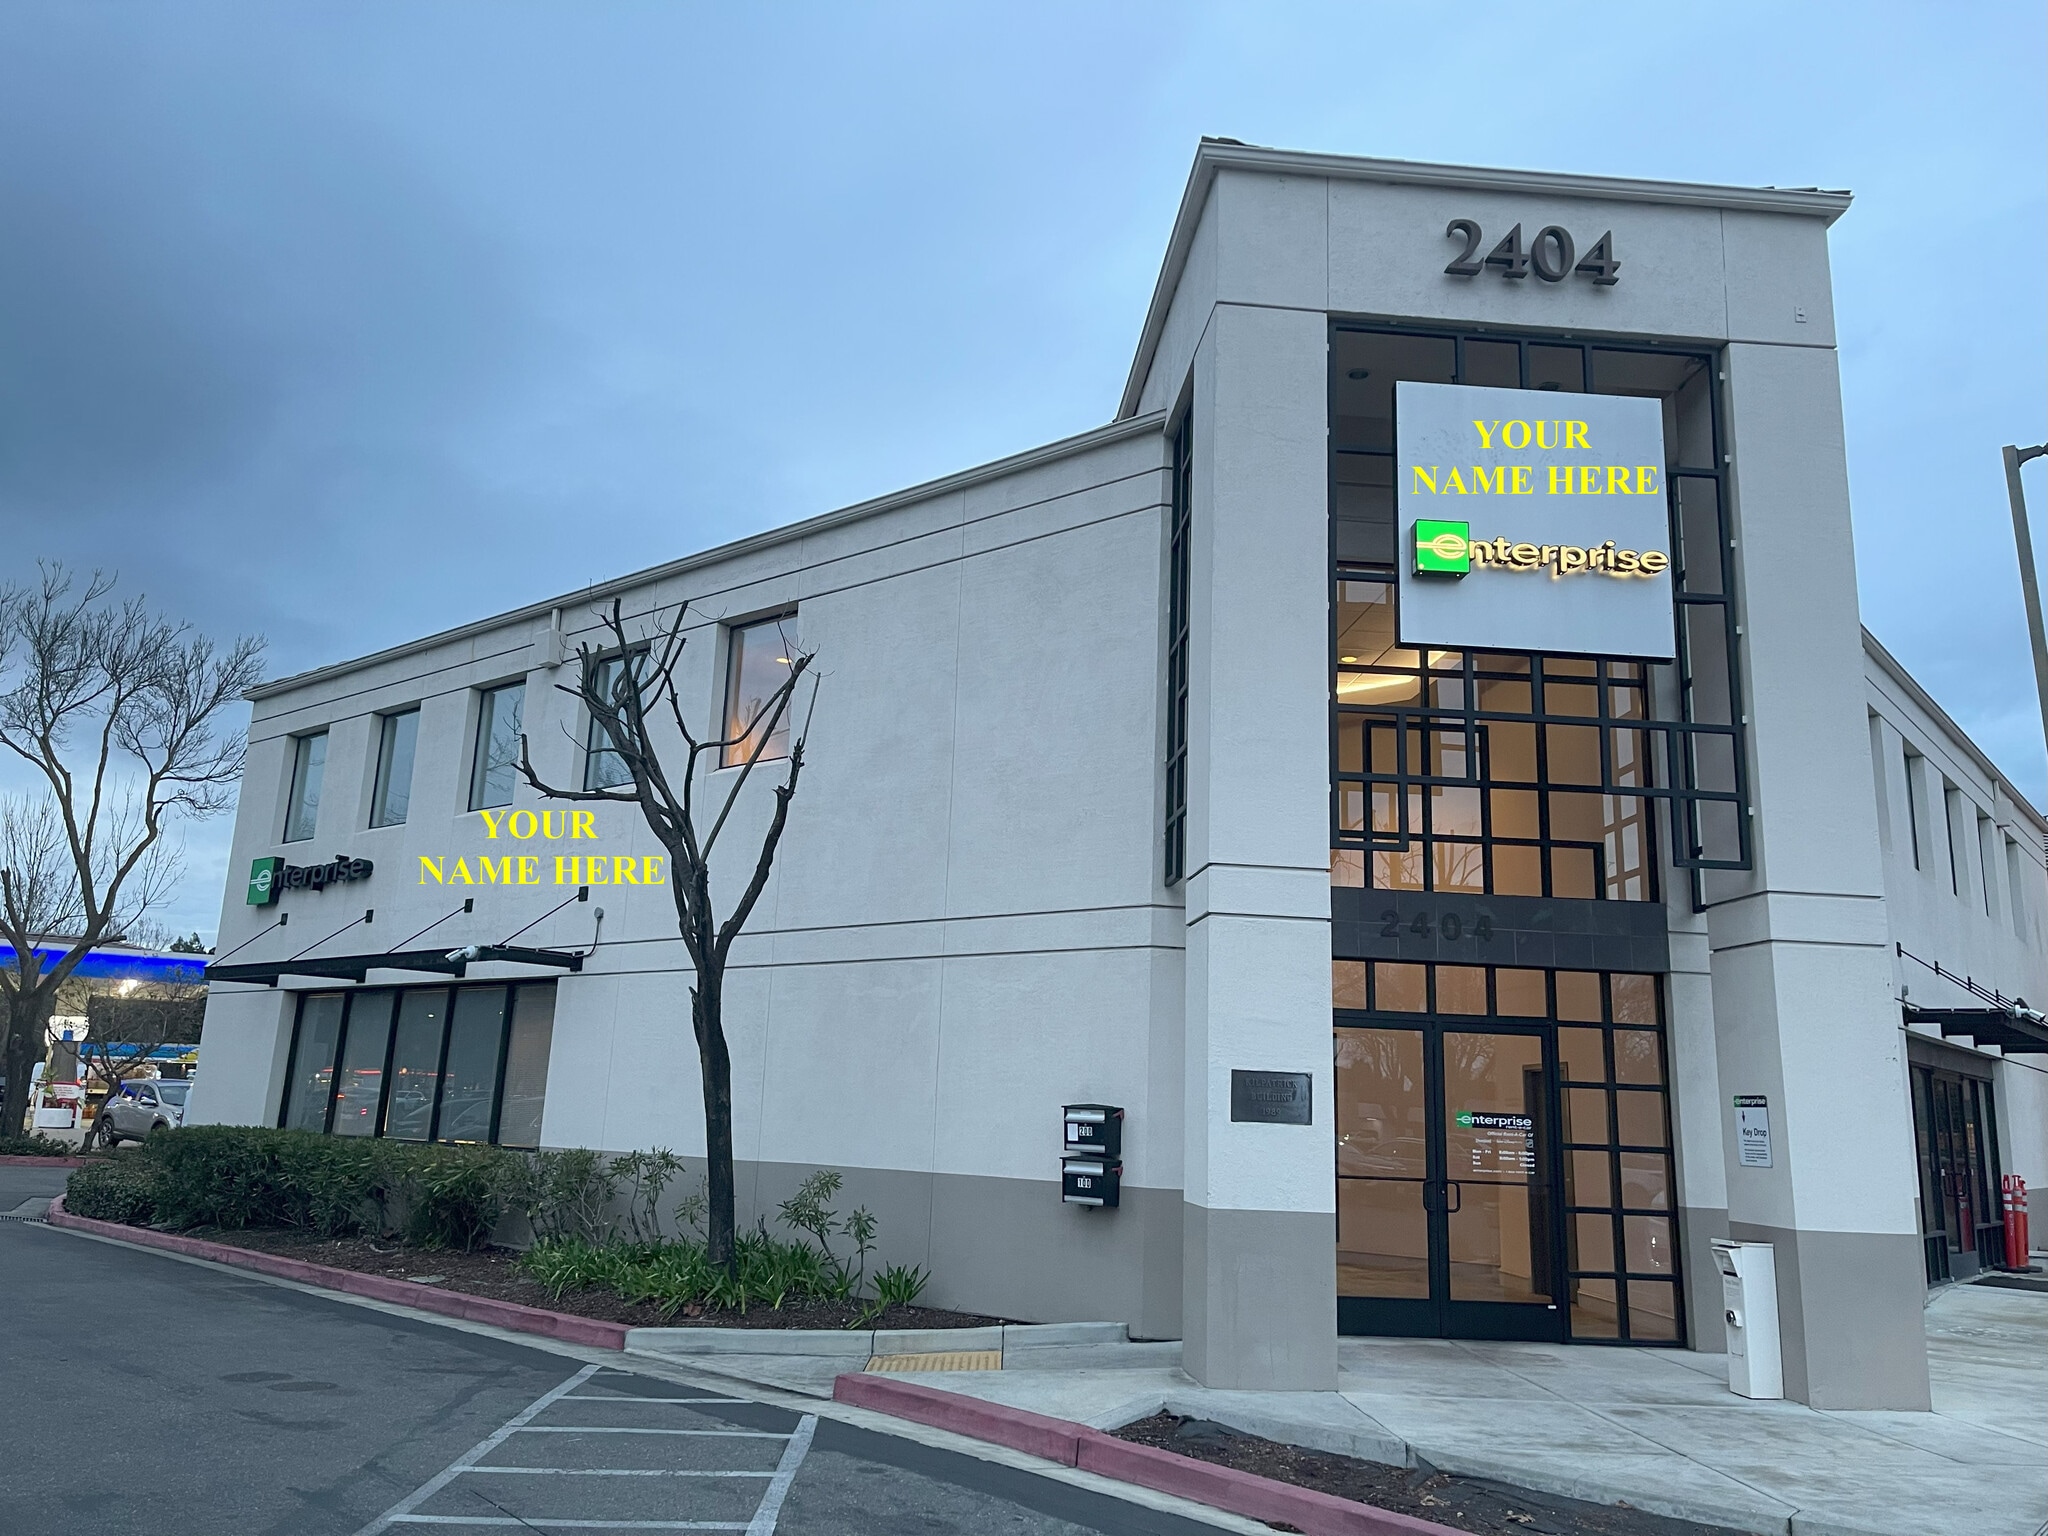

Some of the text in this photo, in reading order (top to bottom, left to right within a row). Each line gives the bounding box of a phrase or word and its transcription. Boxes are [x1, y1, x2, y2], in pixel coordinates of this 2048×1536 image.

[1444, 218, 1622, 286] 2404
[1416, 533, 1669, 576] enterprise
[250, 854, 374, 892] enterprise
[1380, 909, 1494, 942] 2404
[1245, 1078, 1298, 1088] KILPATRICK
[1251, 1091, 1293, 1102] BUILDING
[1735, 1097, 1766, 1106] enterprise
[1456, 1115, 1532, 1127] enterprise
[1079, 1126, 1092, 1136] 200
[1742, 1127, 1767, 1138] Key Drop
